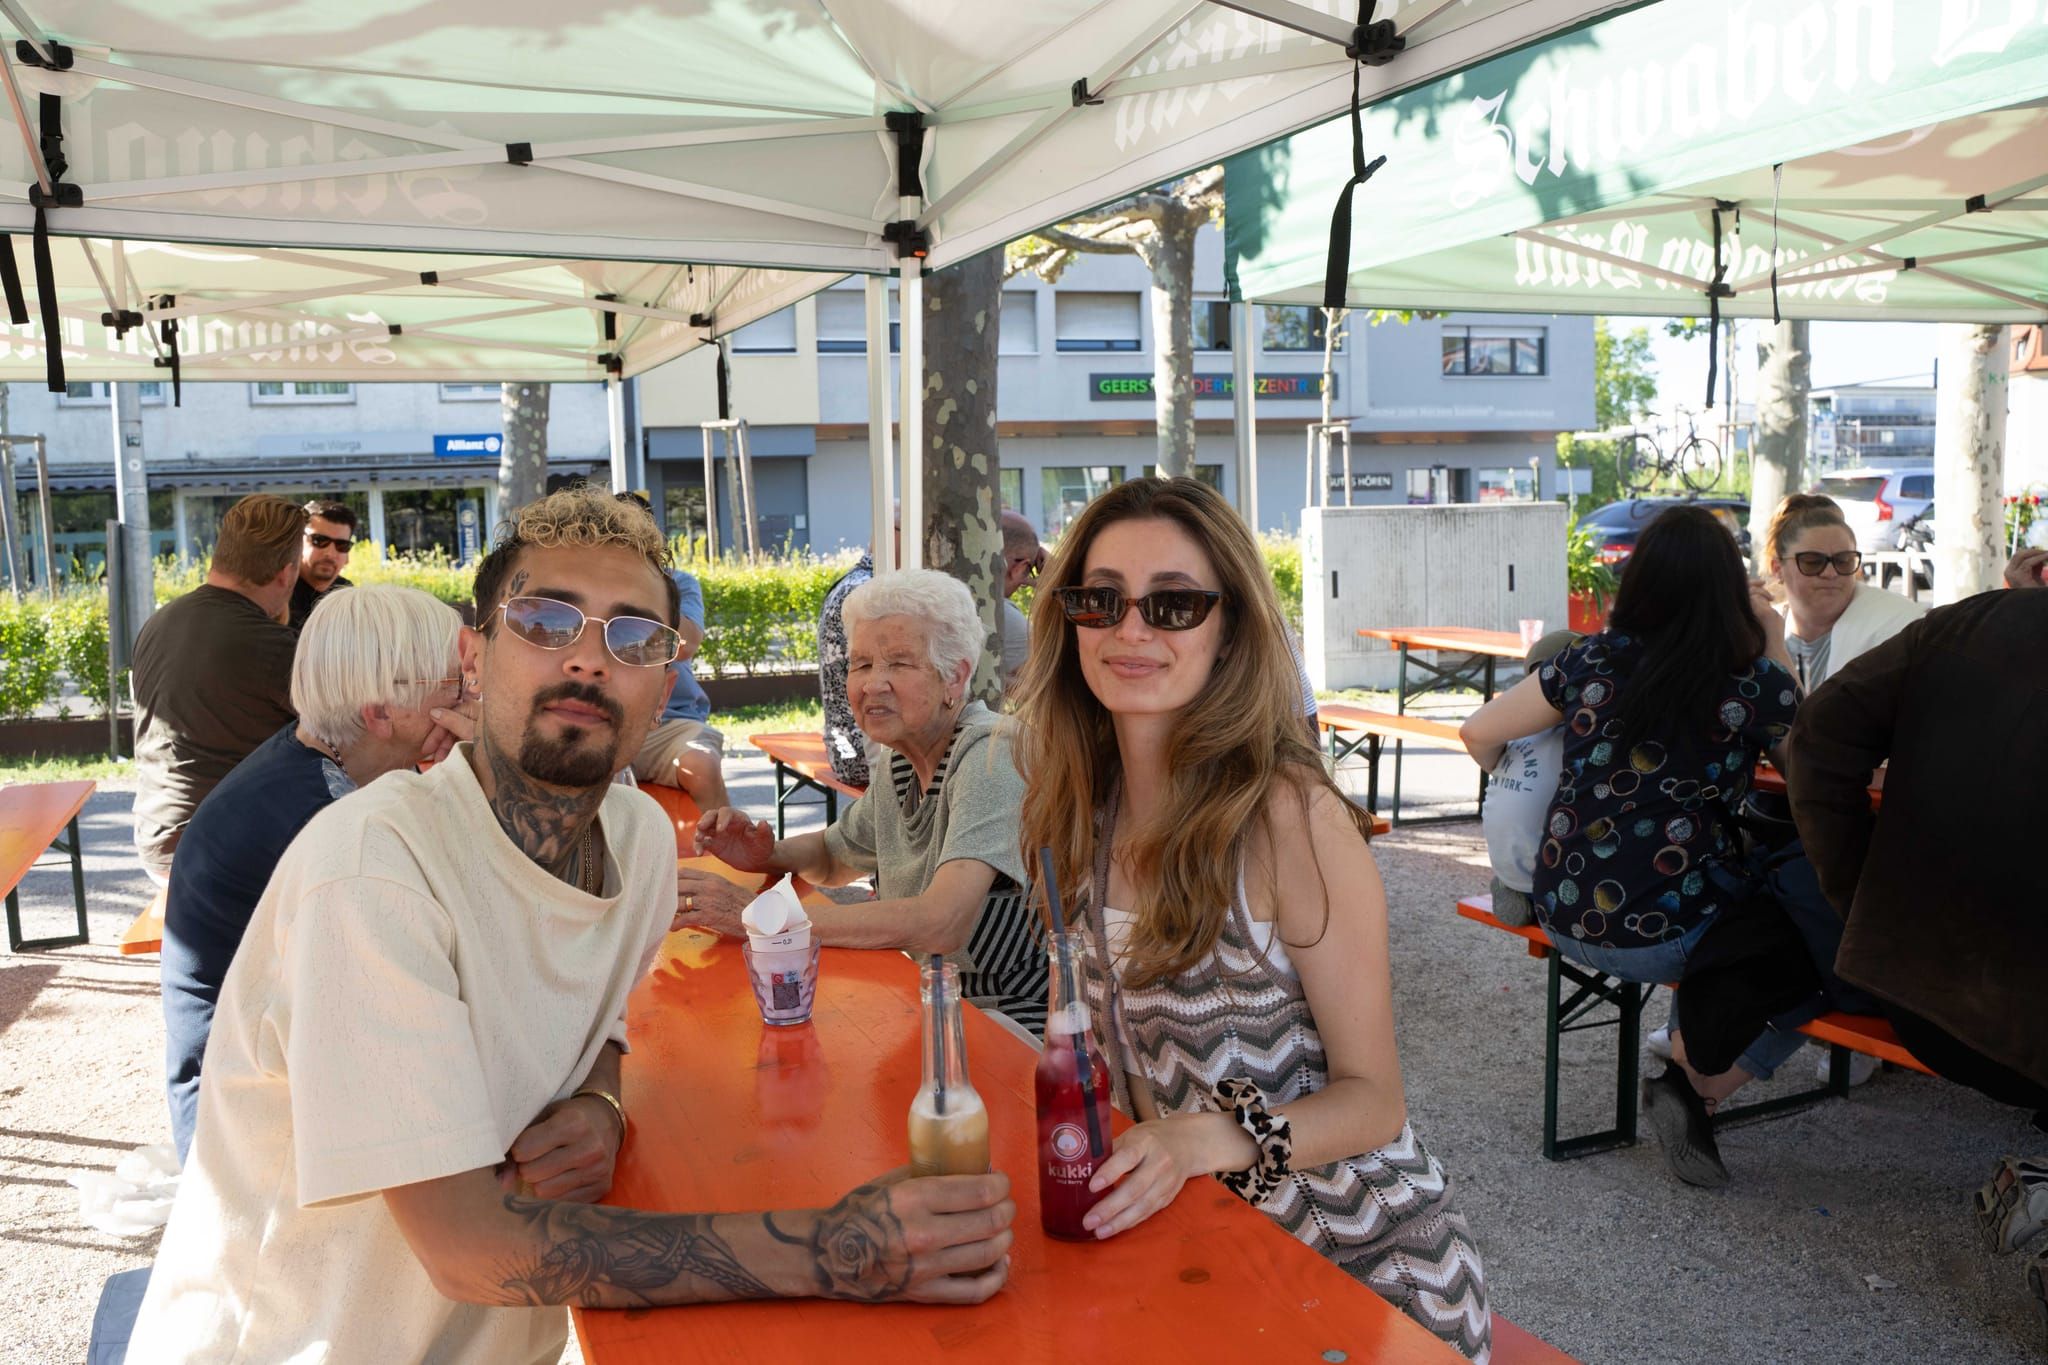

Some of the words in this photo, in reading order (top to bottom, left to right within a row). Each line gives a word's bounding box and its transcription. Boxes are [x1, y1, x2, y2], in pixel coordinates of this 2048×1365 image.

[1449, 0, 1896, 209] Schwaben
[1099, 379, 1148, 394] GEERS
[446, 439, 485, 451] Allianz
[1358, 474, 1391, 486] HÖREN
[1048, 1161, 1092, 1178] kukki
